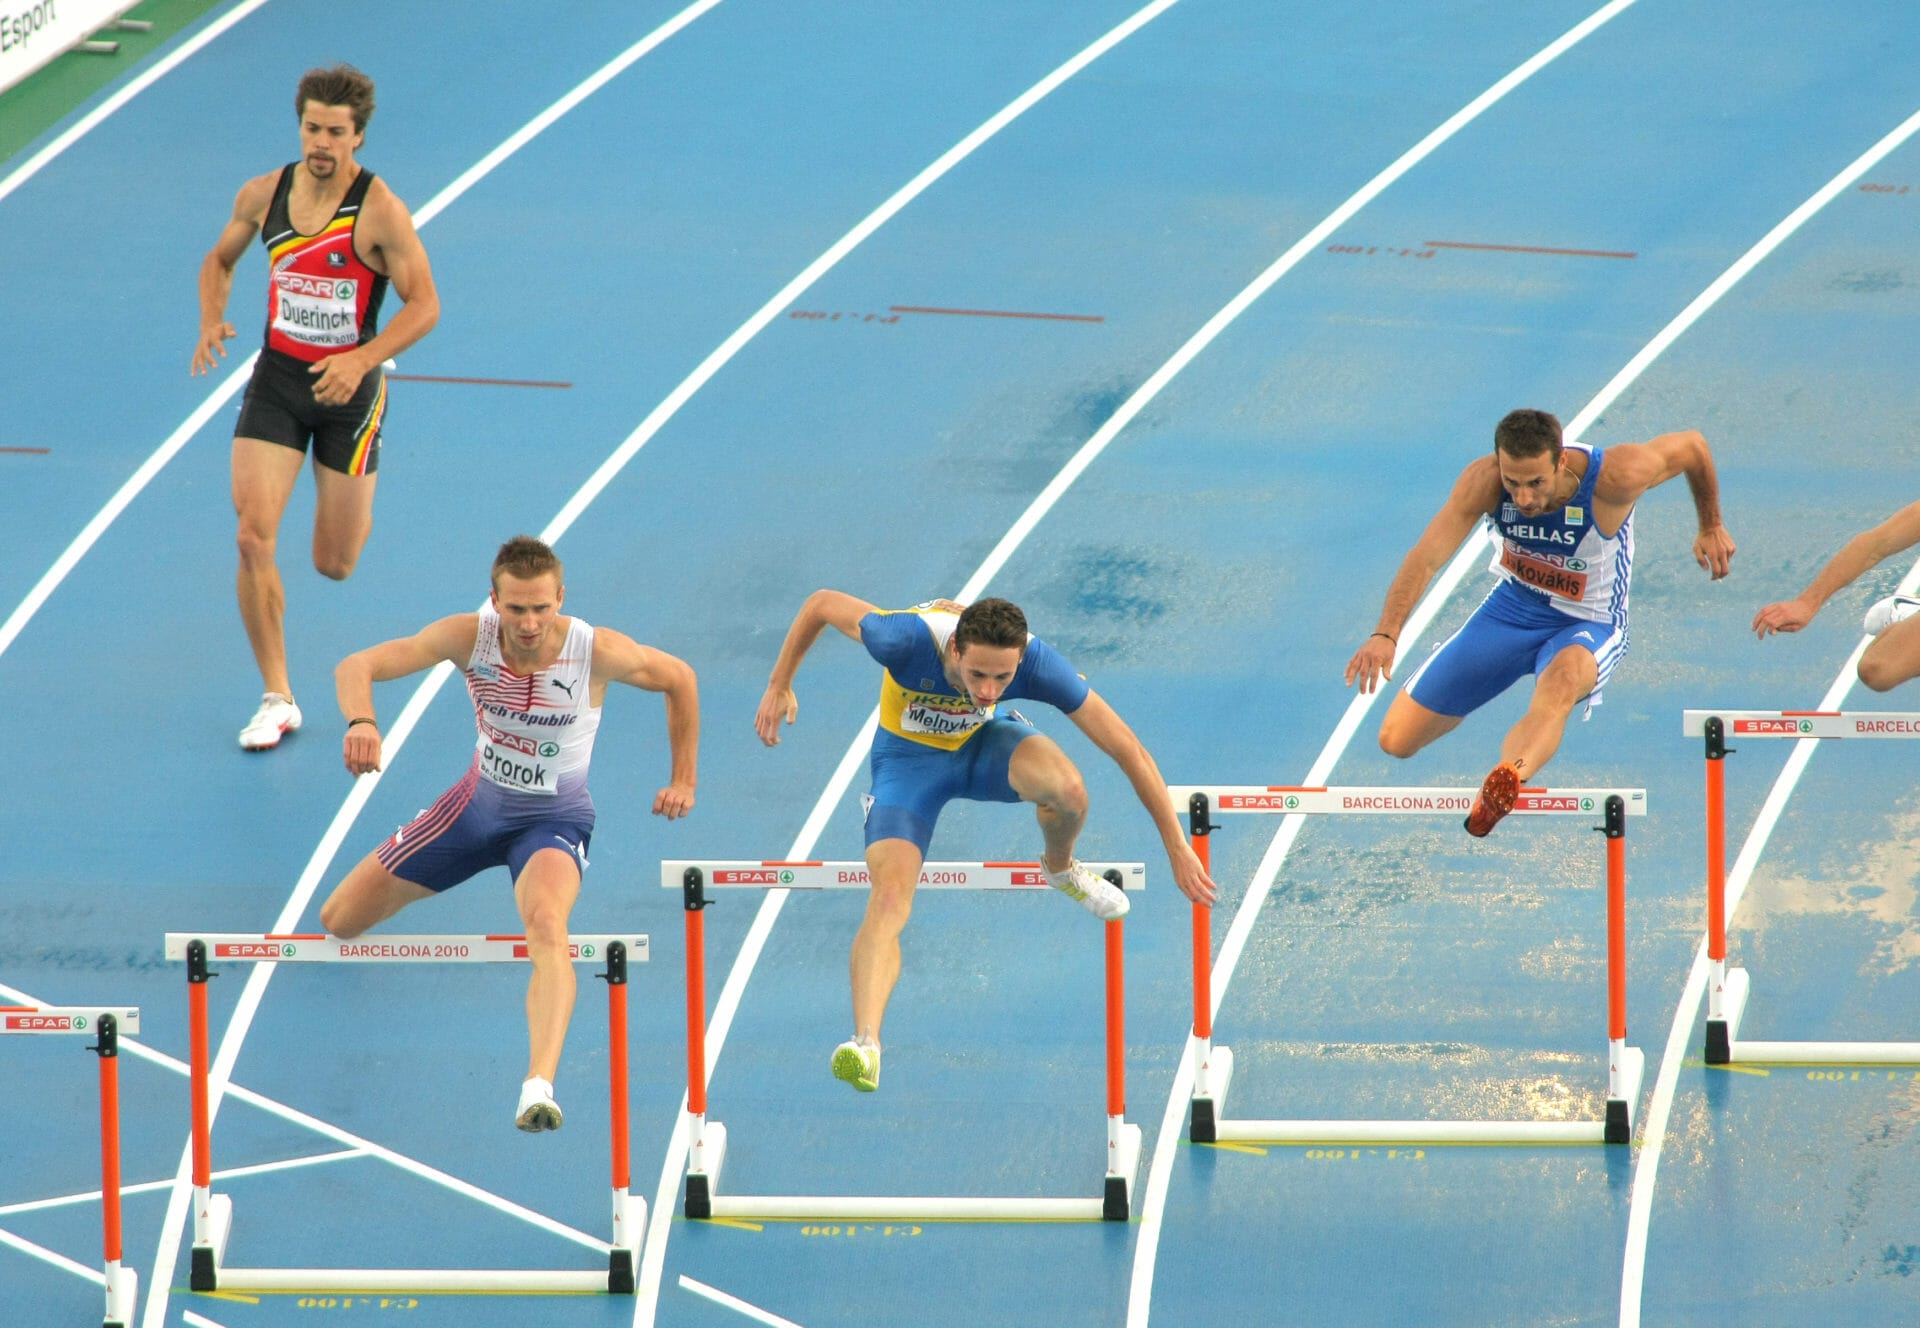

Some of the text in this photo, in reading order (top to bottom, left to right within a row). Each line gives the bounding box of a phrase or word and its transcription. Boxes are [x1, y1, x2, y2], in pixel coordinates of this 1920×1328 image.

[277, 275, 332, 296] SPAR
[282, 297, 351, 330] Duerinck
[336, 332, 356, 344] 2010
[1506, 525, 1576, 545] HELLAS
[1505, 539, 1563, 568] SPAR
[510, 711, 577, 727] republic
[1747, 720, 1797, 731] SPAR
[480, 720, 536, 754] SPAR
[1232, 797, 1577, 809] SPAR BARCELONA 2010 SPAR
[726, 872, 777, 882] SPAR
[932, 872, 967, 884] 2010
[228, 945, 470, 957] SPAR BARCELONA 2010
[19, 1017, 71, 1028] SPAR
